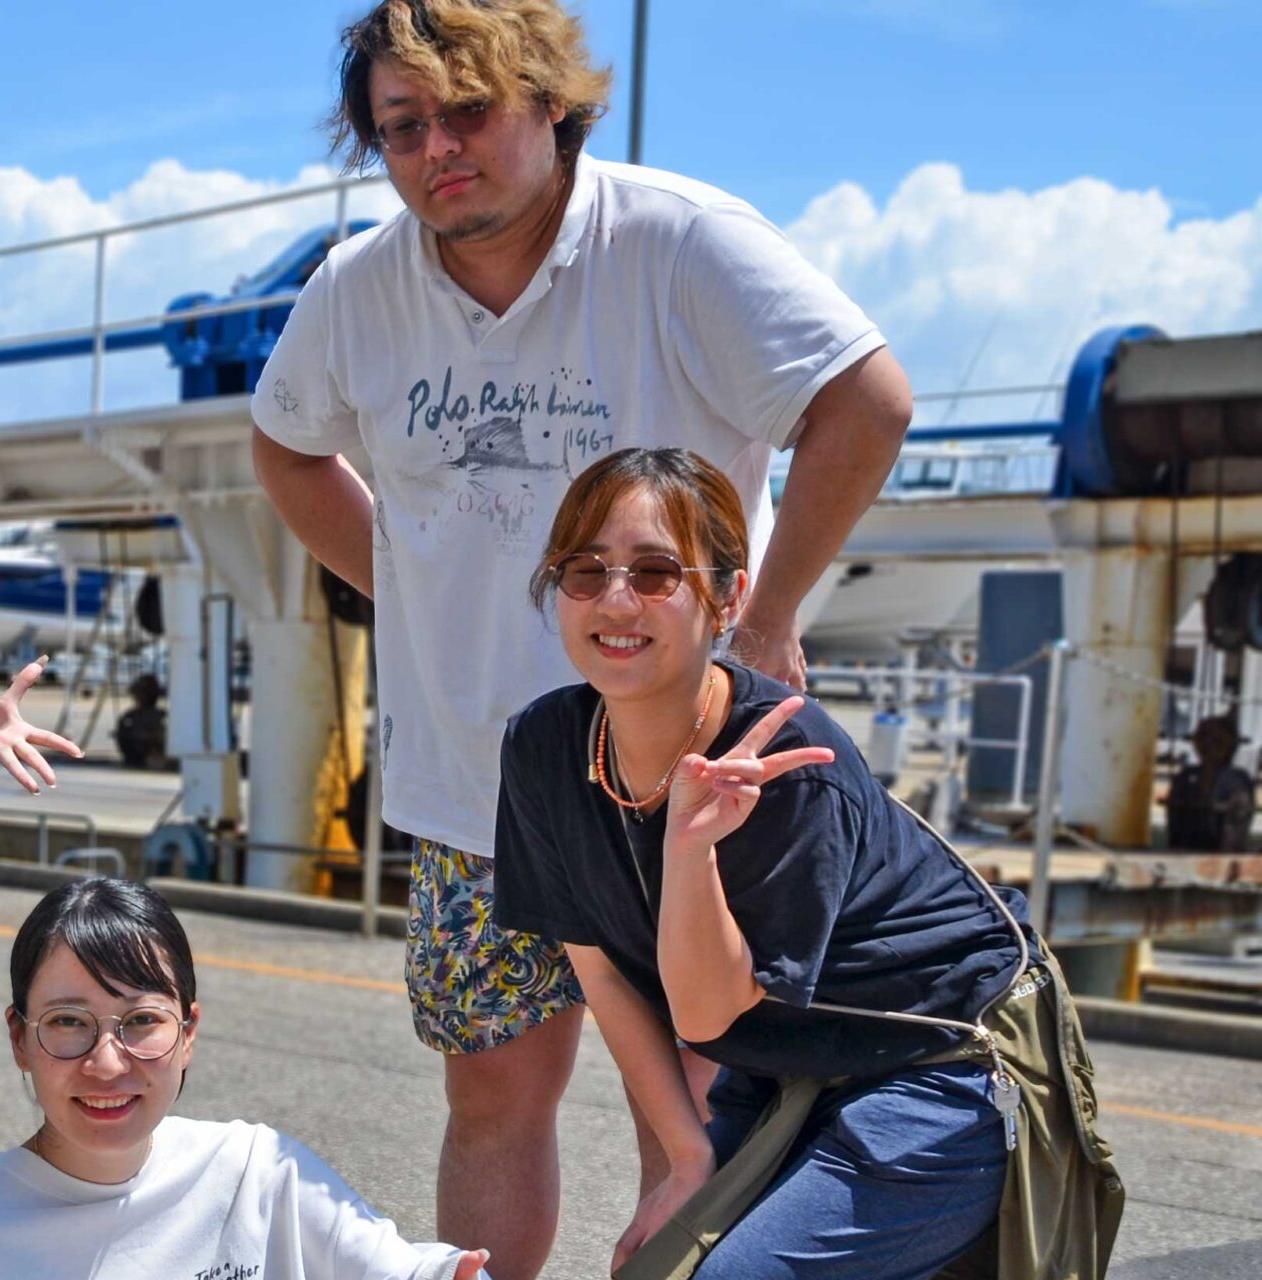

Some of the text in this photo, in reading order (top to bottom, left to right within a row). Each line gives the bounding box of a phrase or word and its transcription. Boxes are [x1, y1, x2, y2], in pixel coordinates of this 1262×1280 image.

[407, 366, 470, 438] Polo
[480, 380, 539, 426] Ralph
[569, 428, 614, 458] 1967
